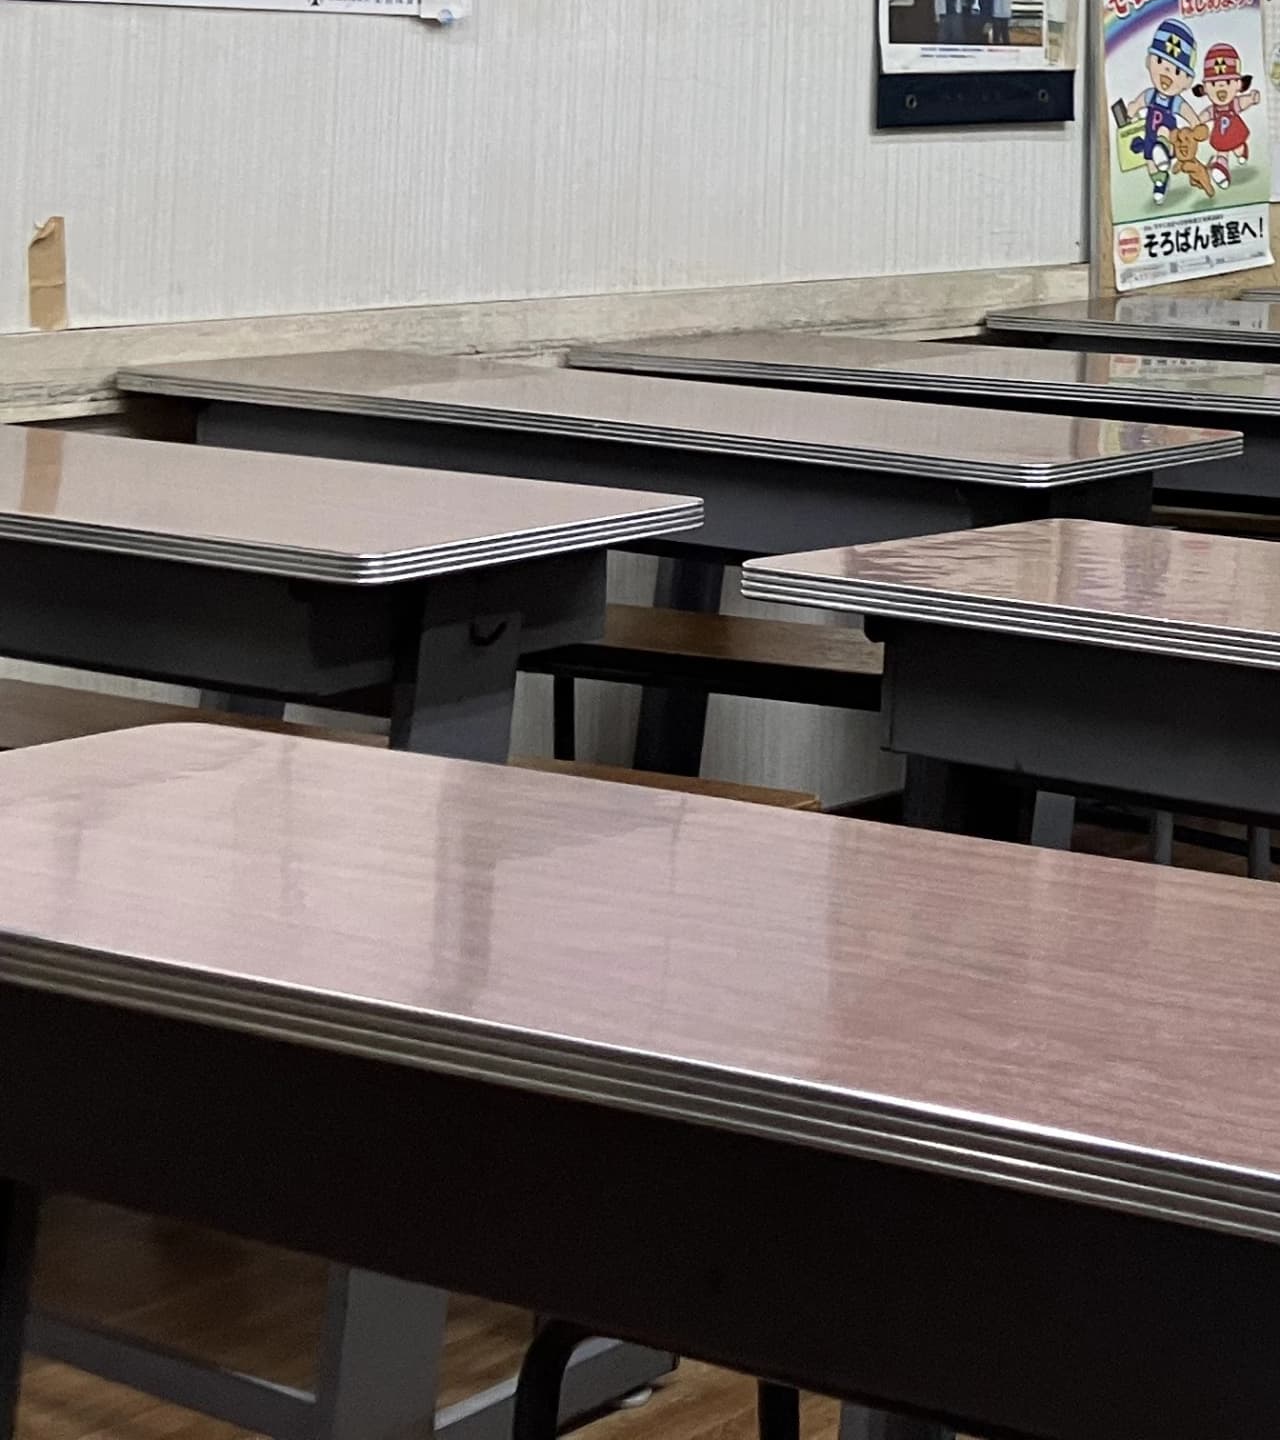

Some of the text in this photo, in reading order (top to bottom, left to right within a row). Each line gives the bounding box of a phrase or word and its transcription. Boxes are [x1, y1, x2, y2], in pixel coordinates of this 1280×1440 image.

[1151, 111, 1163, 131] P
[1220, 117, 1230, 136] P
[1143, 216, 1265, 260] そろばん教室へ!
